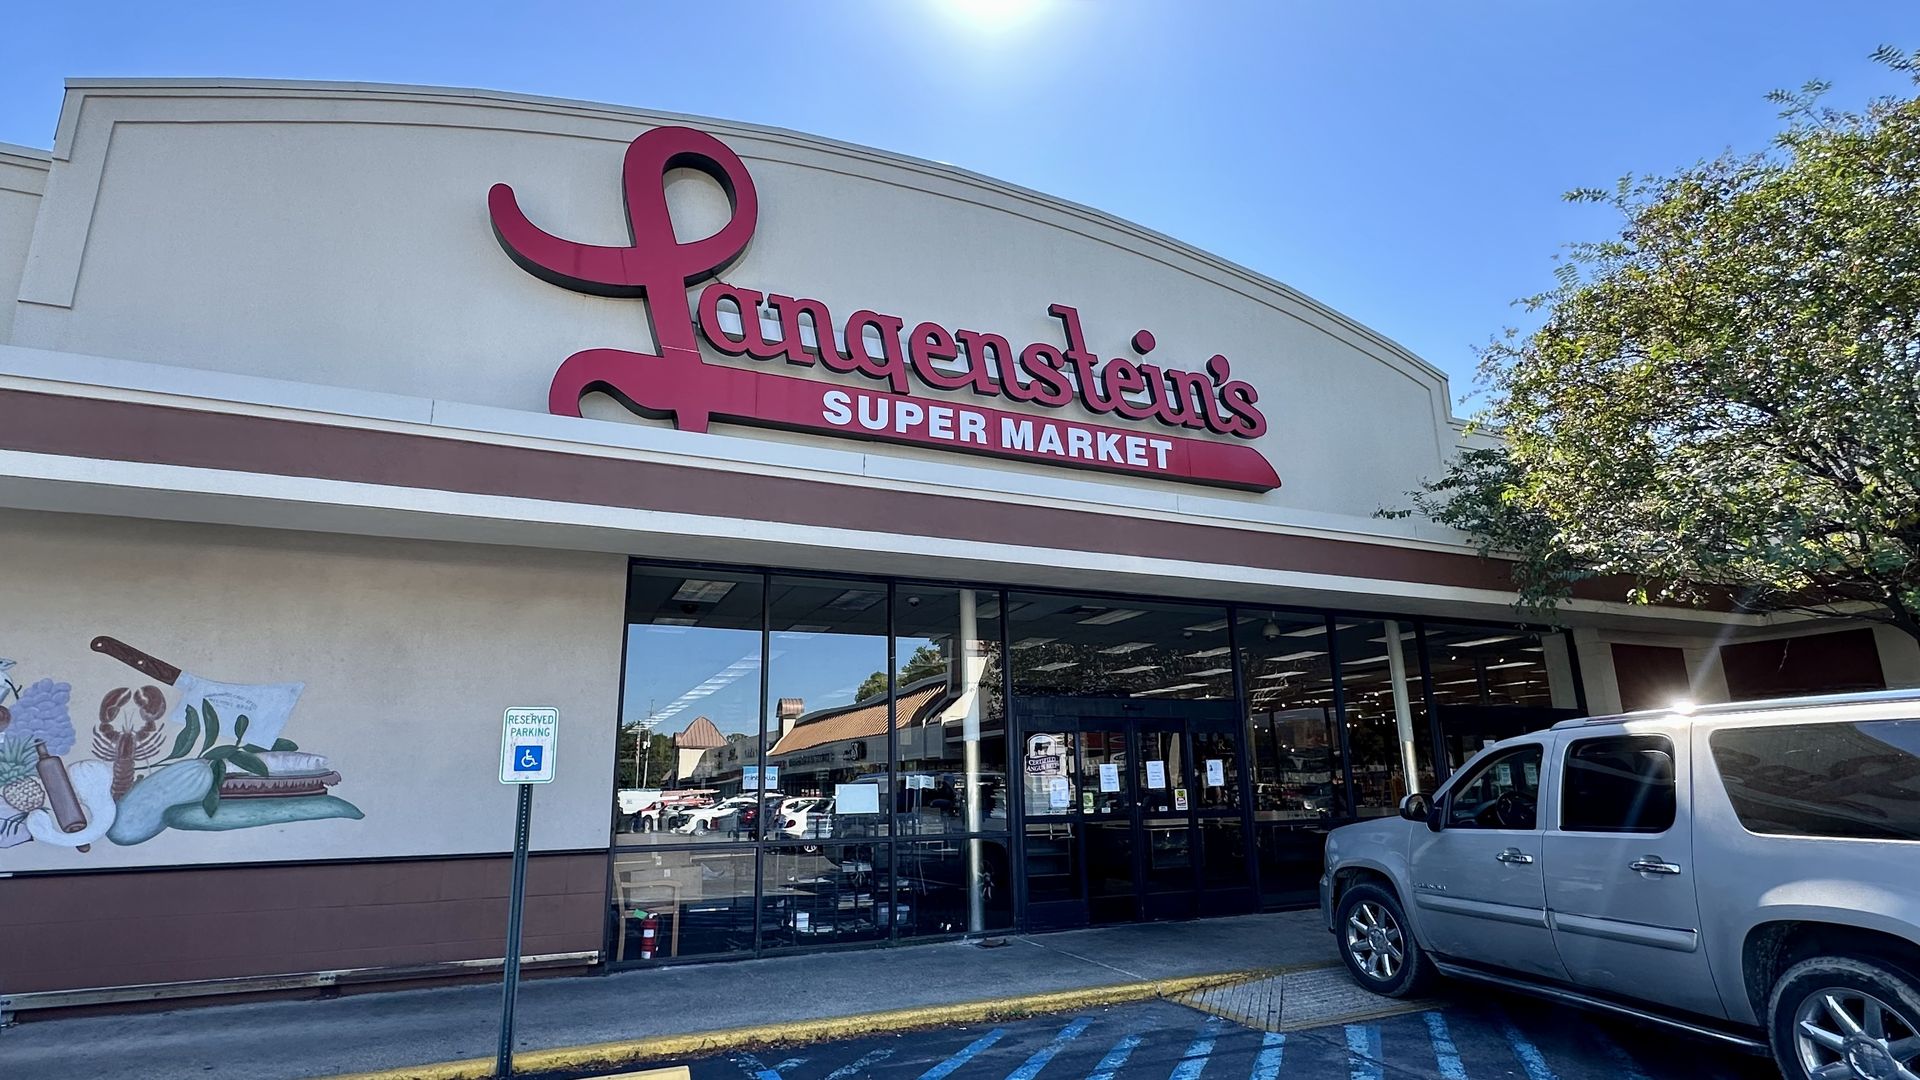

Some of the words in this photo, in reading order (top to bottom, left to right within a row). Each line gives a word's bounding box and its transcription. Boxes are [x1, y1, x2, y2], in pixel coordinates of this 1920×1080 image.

[488, 126, 1267, 439] Langenstein's
[822, 390, 988, 445] SUPER
[1001, 417, 1173, 469] MARKET
[508, 715, 554, 725] RESERVED
[510, 727, 550, 737] PARKING
